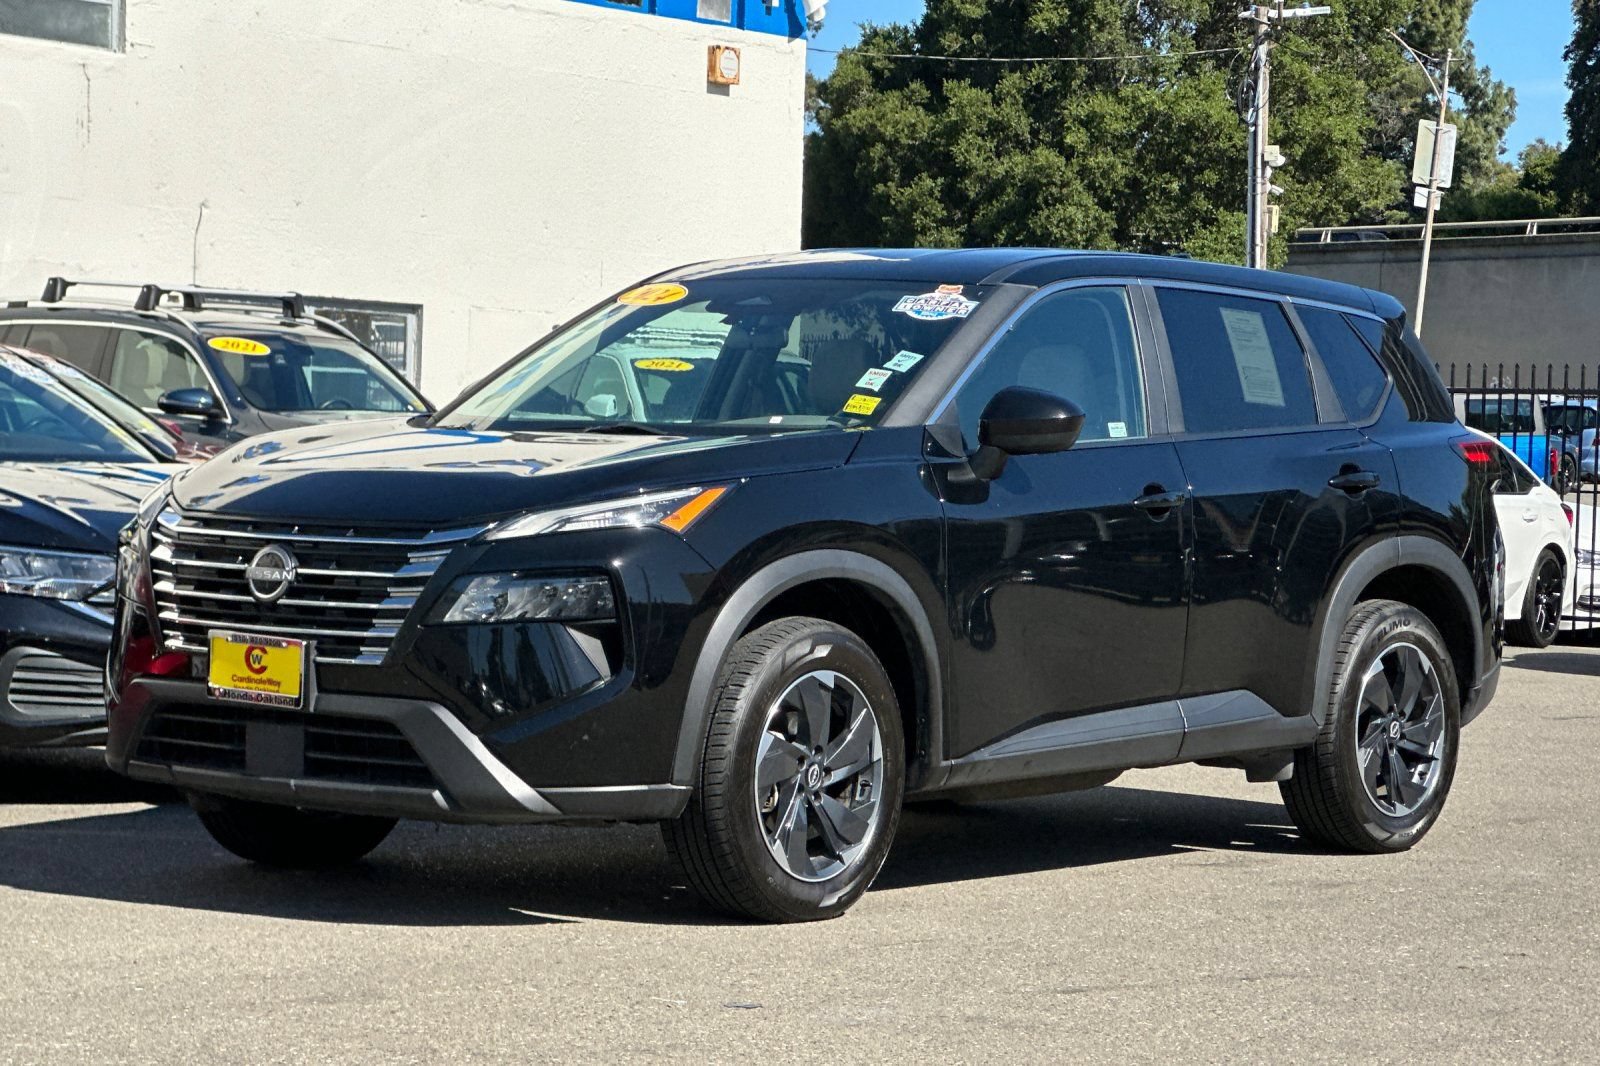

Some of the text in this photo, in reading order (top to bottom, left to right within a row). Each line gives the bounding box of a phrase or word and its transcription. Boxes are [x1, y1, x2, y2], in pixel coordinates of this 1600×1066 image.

[222, 340, 257, 352] 2021
[645, 360, 683, 369] 2021
[247, 568, 293, 580] SSAN
[231, 674, 281, 688] CardinaleWay
[223, 689, 294, 707] Honda Oakland
